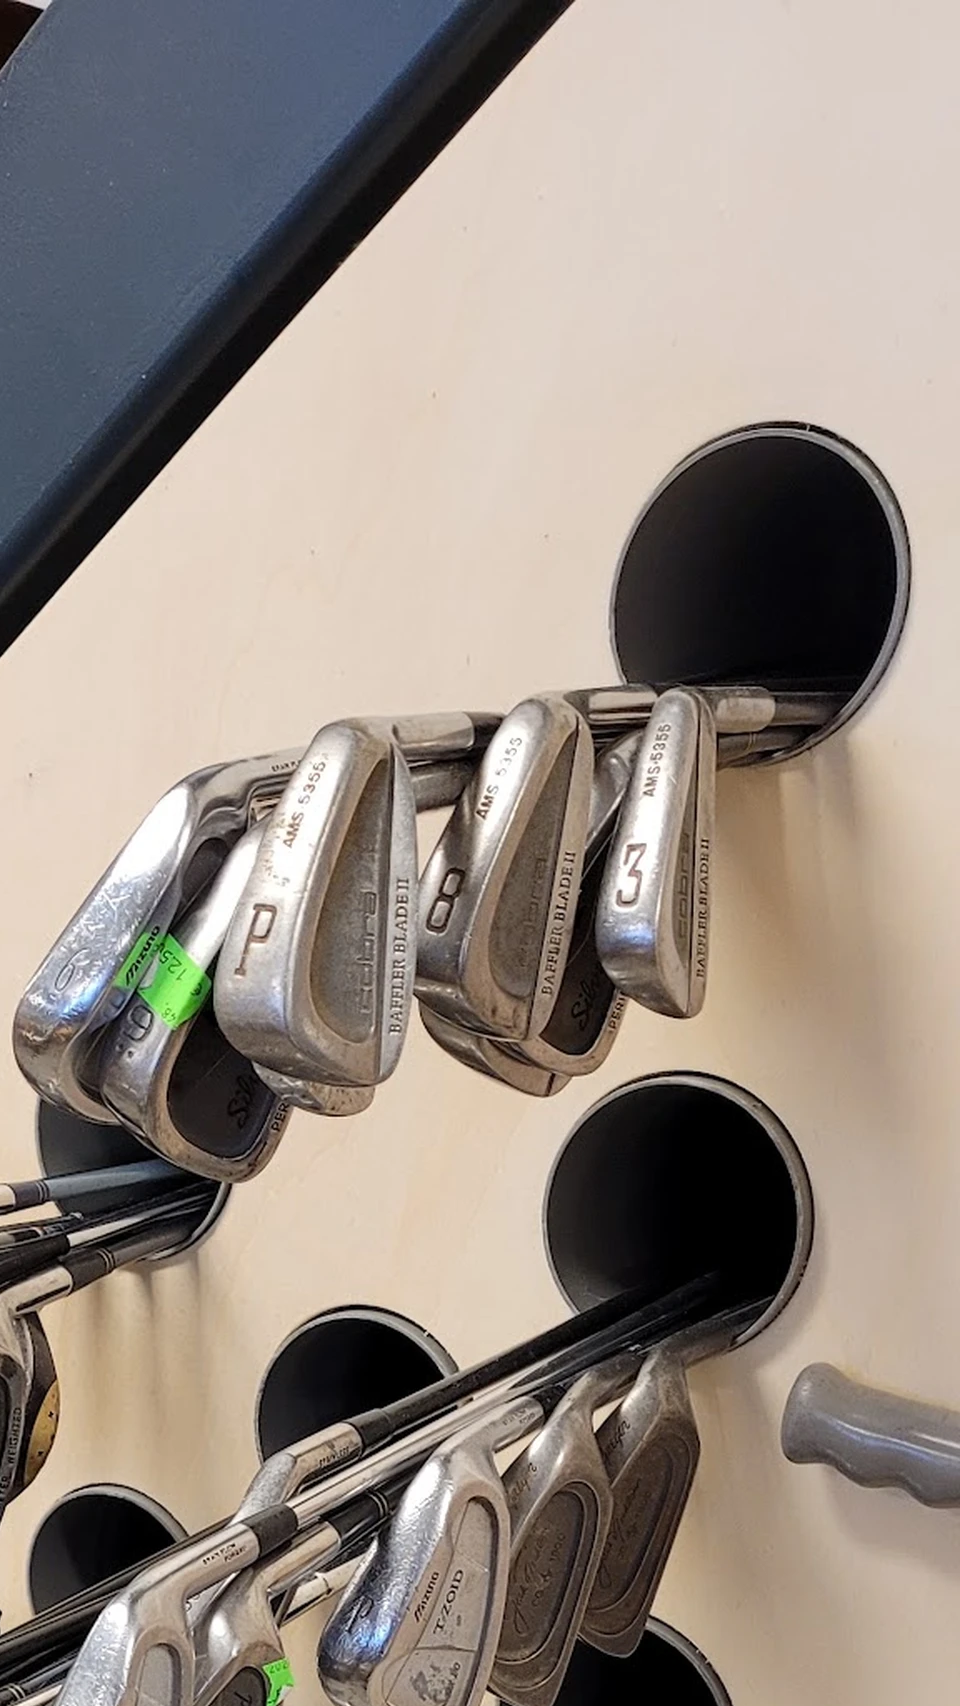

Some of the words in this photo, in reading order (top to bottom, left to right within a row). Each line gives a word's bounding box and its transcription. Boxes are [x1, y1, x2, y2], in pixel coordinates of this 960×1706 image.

[426, 867, 466, 934] 8
[615, 842, 647, 910] 3
[234, 903, 277, 977] P
[393, 902, 409, 954] BLADE
[541, 922, 565, 996] BAFFLER
[553, 871, 574, 922] BLADE
[389, 959, 407, 1036] BAFFLER
